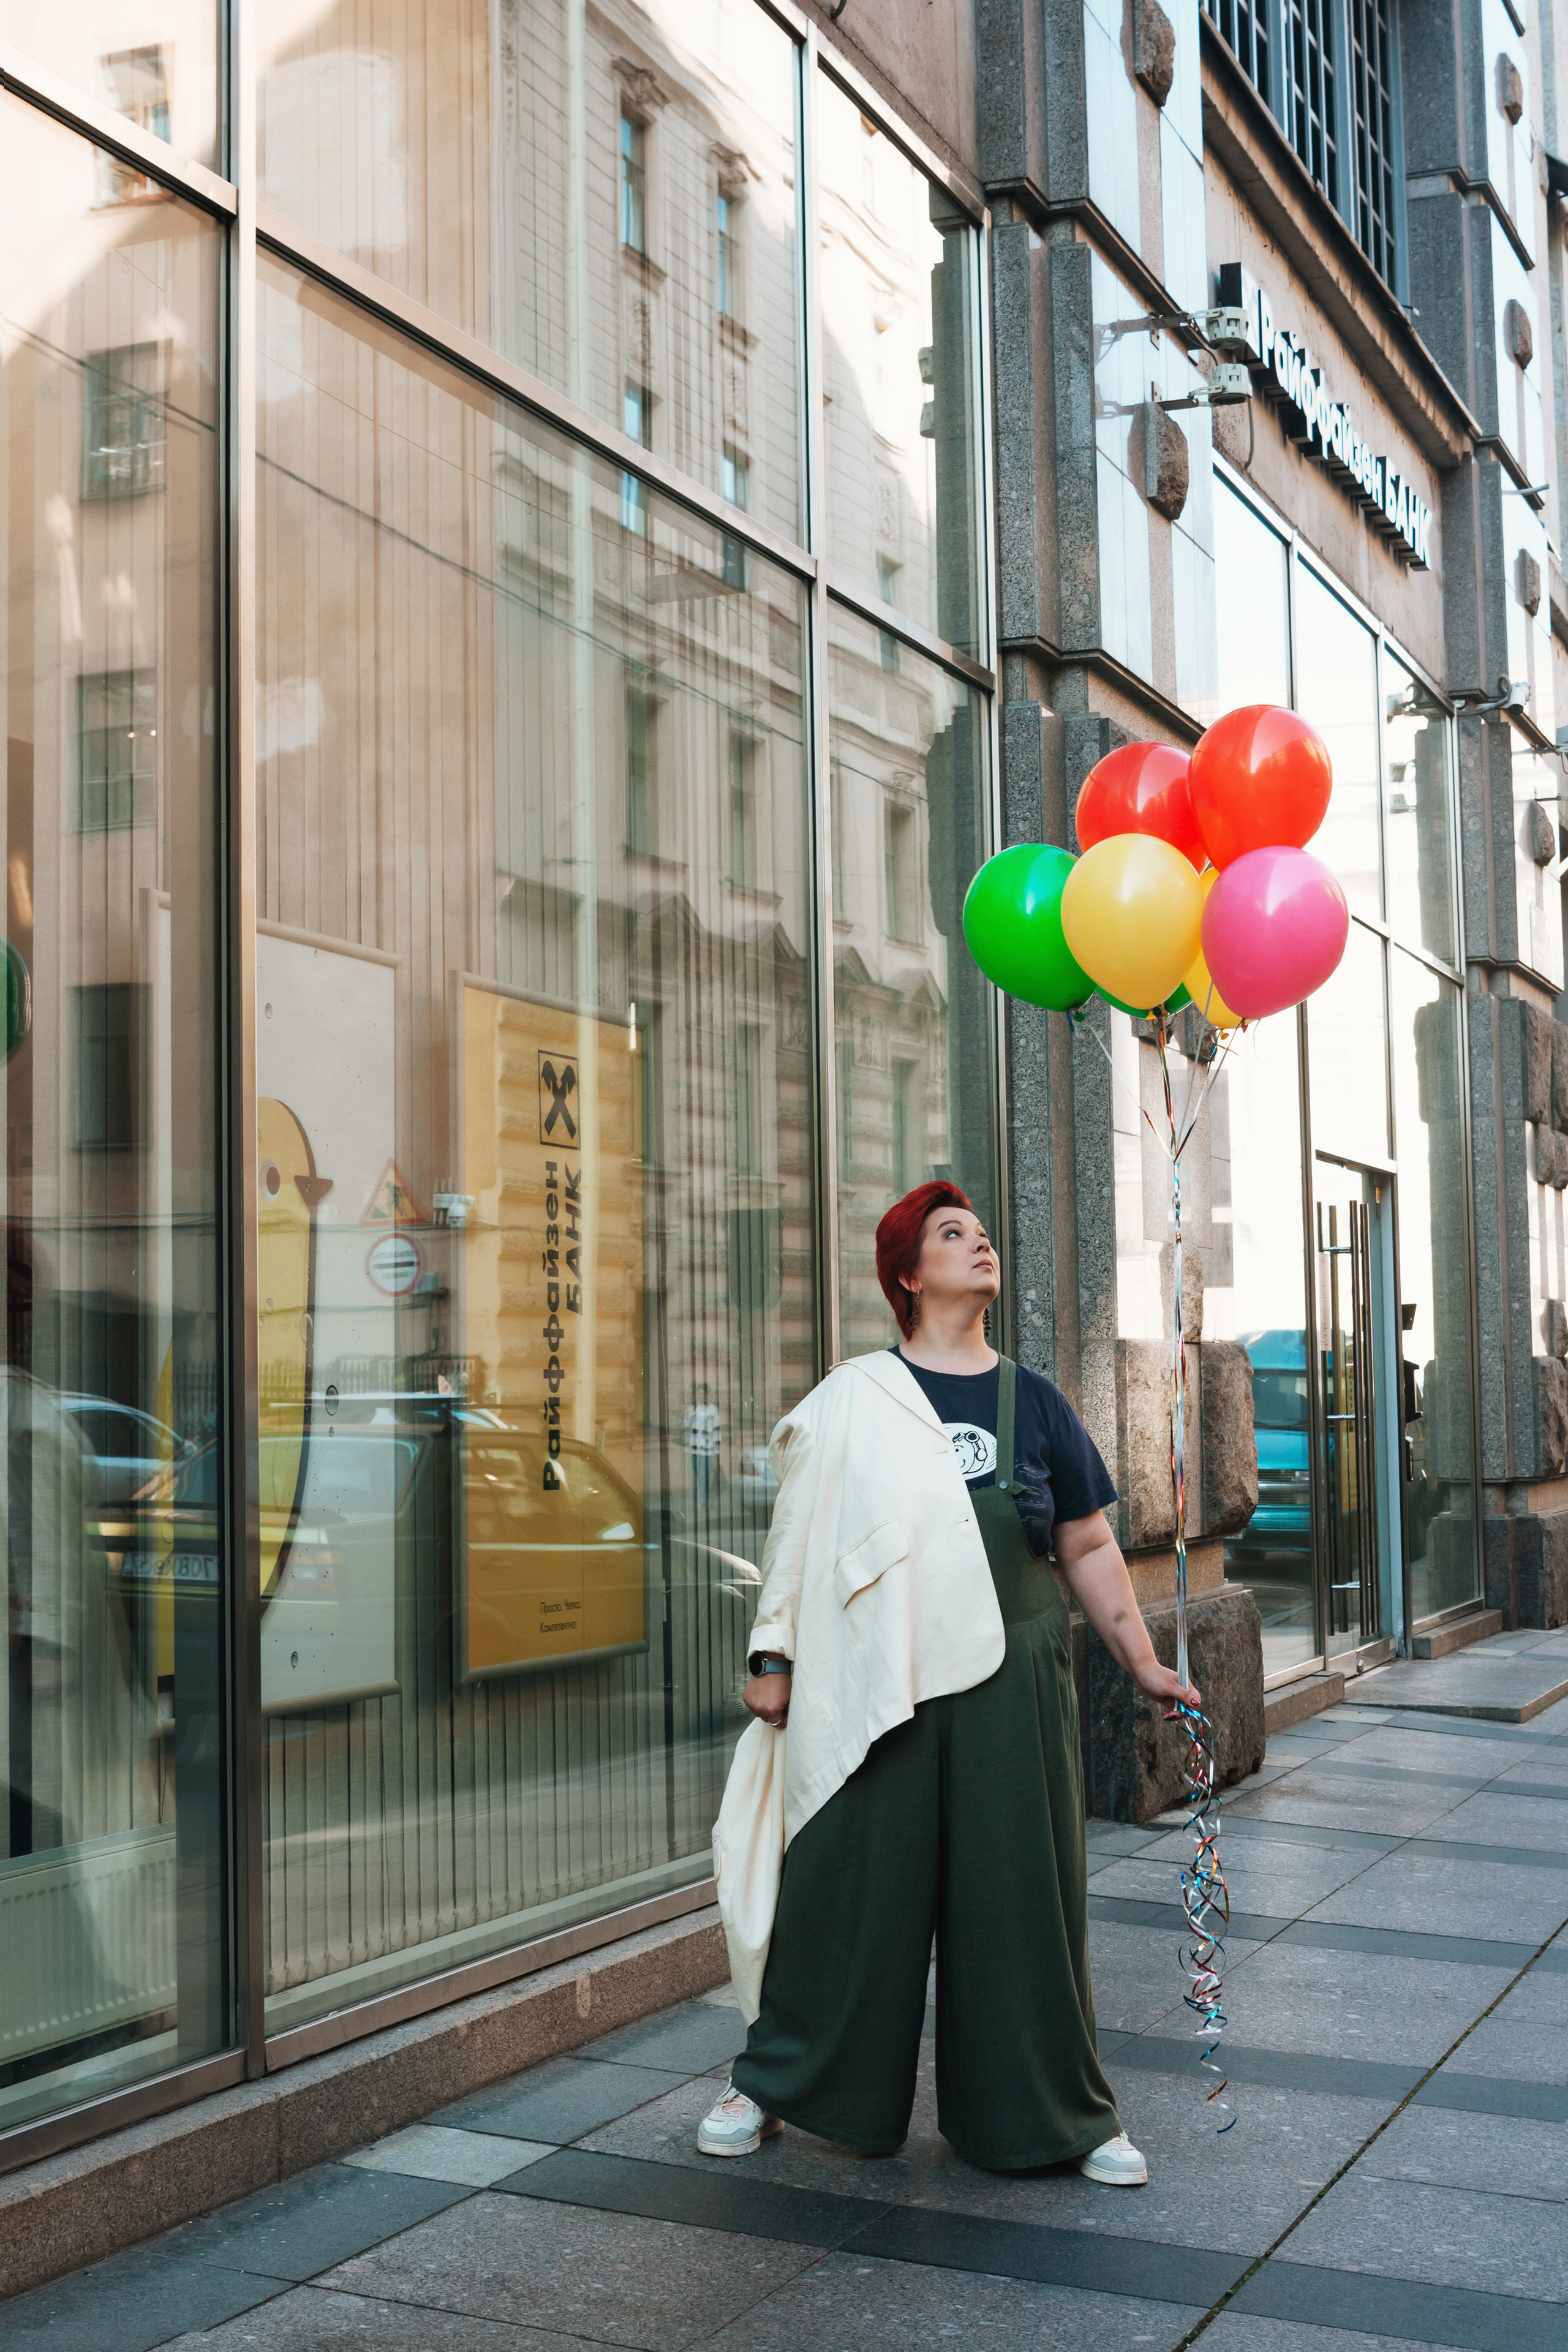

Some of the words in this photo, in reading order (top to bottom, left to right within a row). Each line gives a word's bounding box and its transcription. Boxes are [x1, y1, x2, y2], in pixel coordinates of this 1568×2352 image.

[1260, 289, 1383, 510] Райффайзен
[1385, 456, 1433, 570] БАНК
[565, 1161, 582, 1316] БАНК
[542, 1161, 565, 1491] Райффайзен
[540, 1602, 563, 1616] Просто.
[564, 1599, 582, 1610] Четко.
[540, 1621, 578, 1634] Компетентно.
